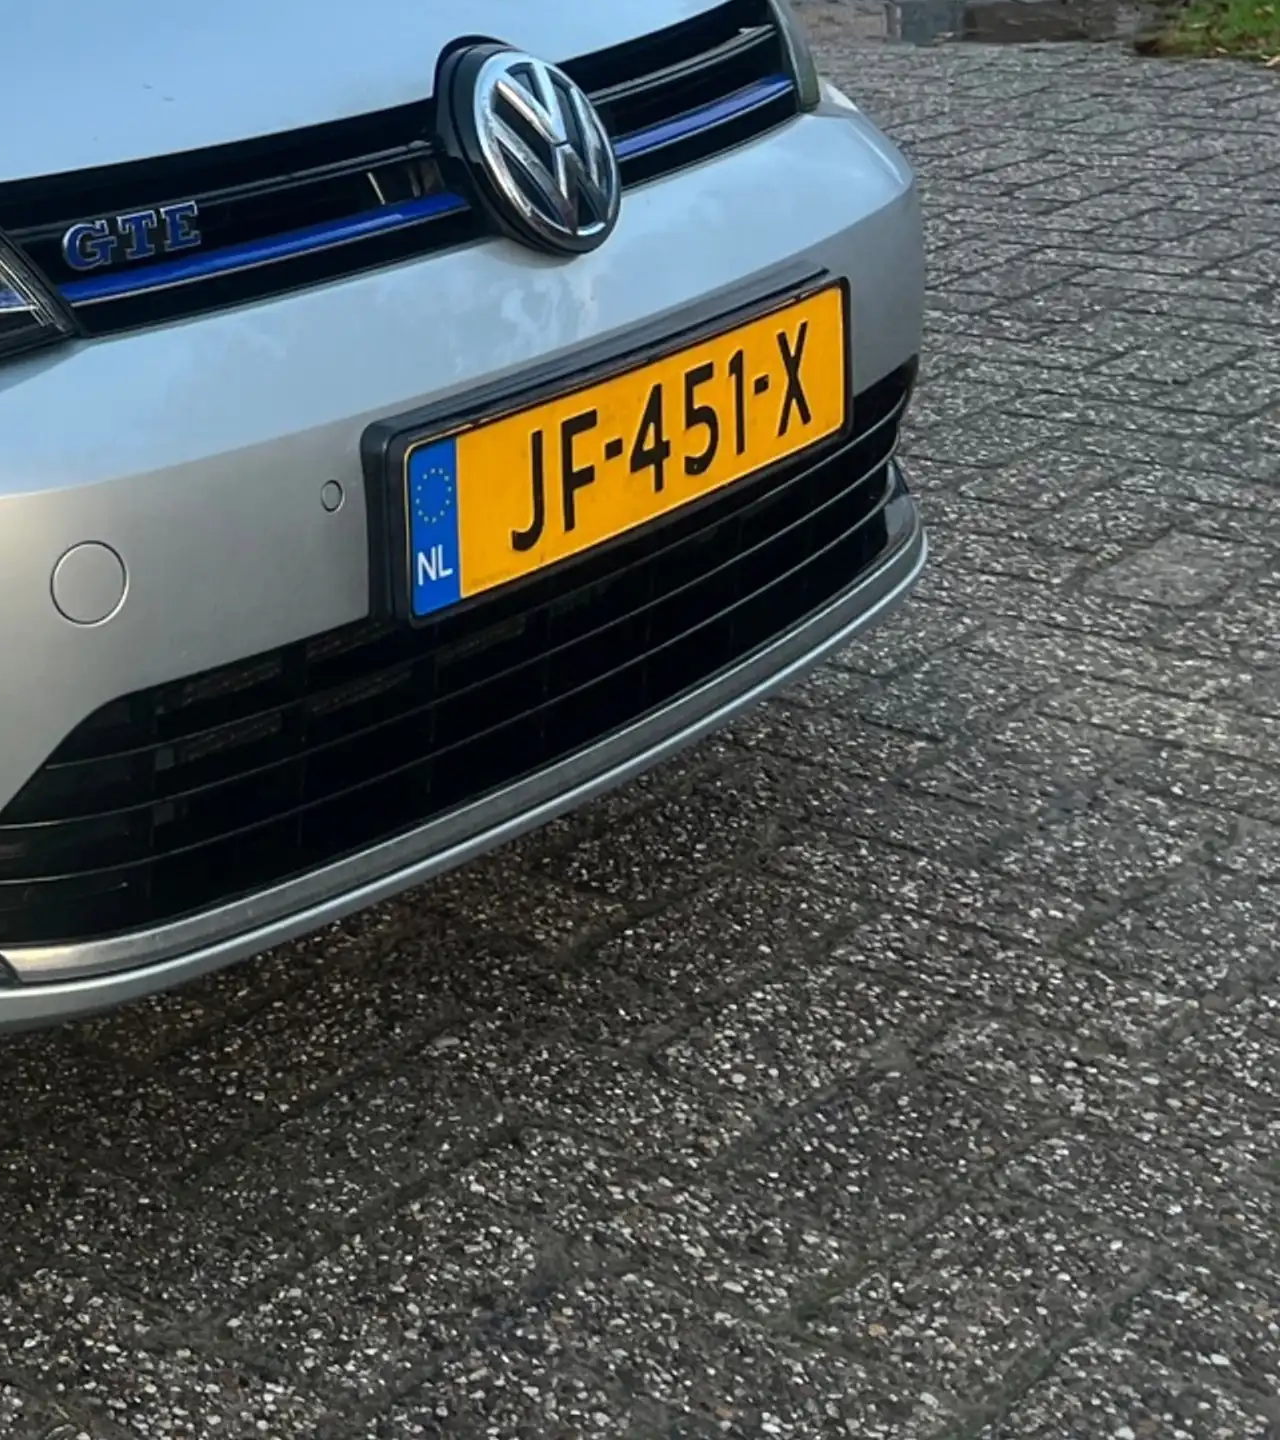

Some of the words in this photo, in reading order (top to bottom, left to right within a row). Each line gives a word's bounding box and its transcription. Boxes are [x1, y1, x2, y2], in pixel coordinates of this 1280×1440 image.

[63, 200, 202, 271] GTE
[511, 320, 811, 552] JF-451-X
[416, 544, 454, 586] NL
